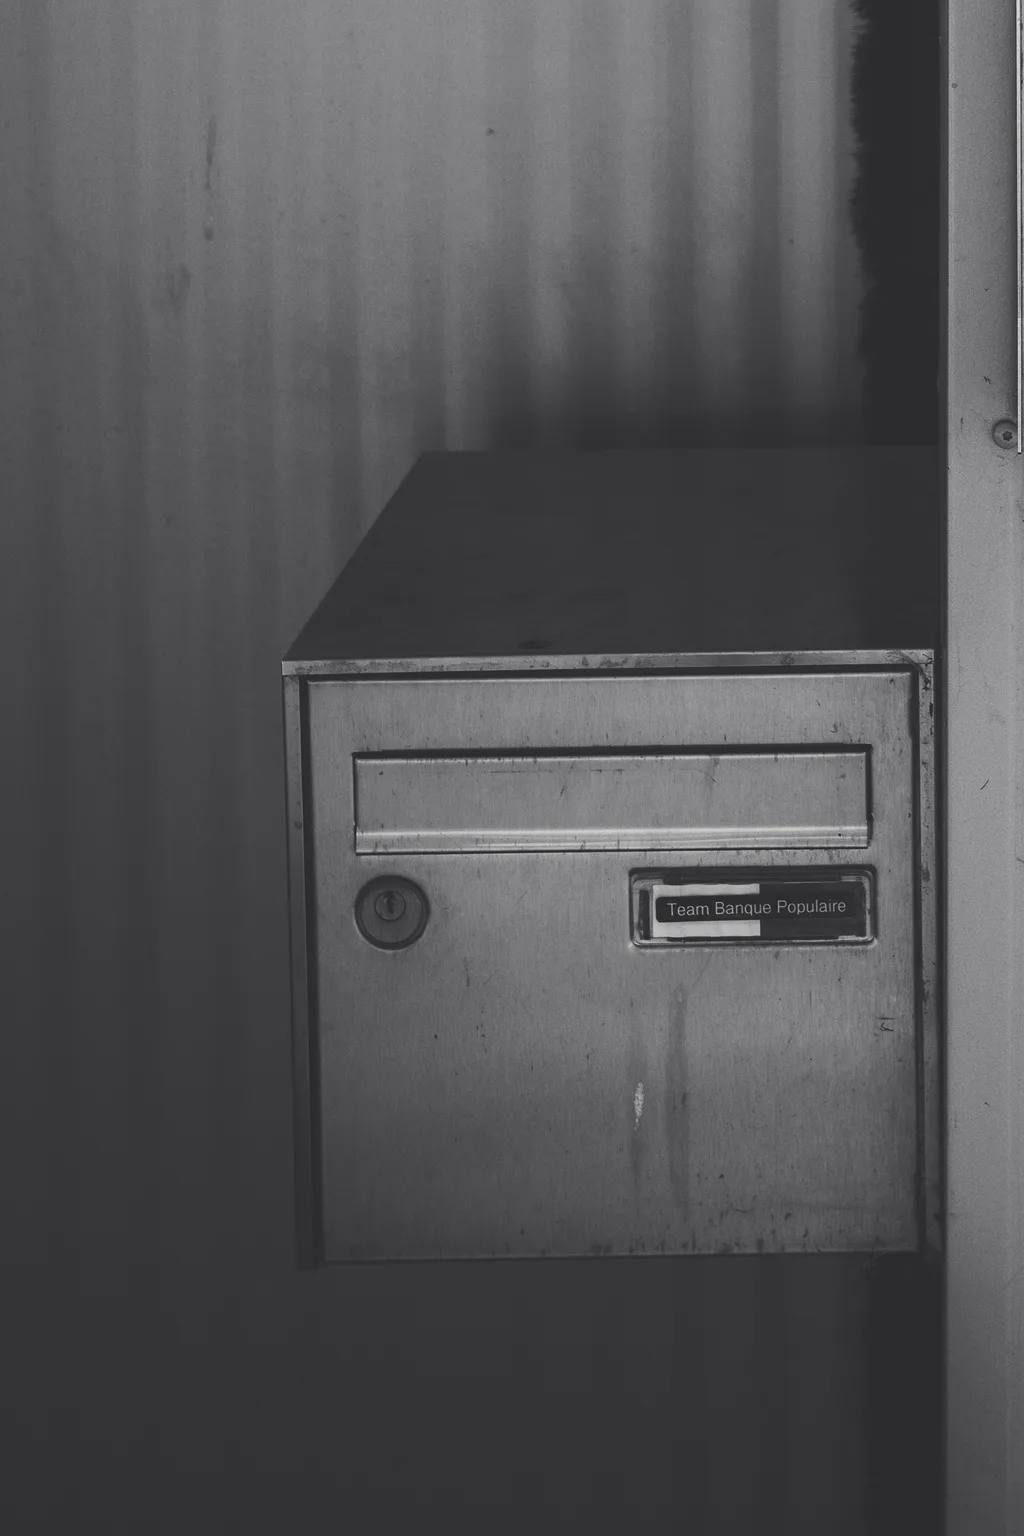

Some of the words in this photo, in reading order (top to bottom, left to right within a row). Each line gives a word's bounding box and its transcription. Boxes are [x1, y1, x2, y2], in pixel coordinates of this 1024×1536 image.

[667, 902, 710, 916] Team
[715, 901, 772, 916] Banque
[777, 899, 847, 915] Populaire
